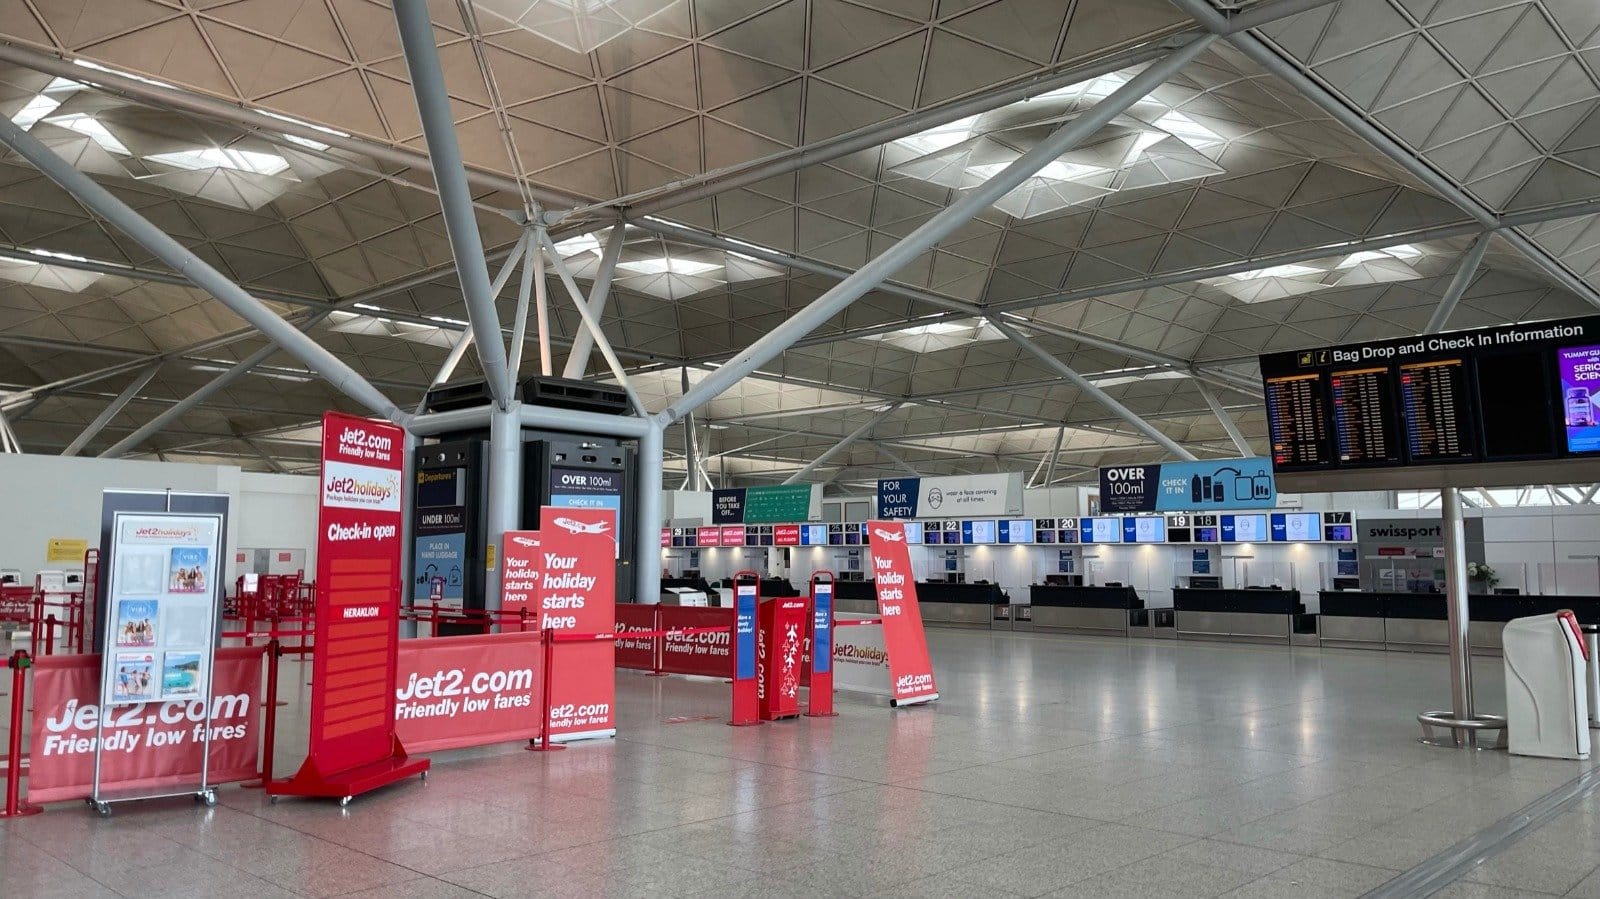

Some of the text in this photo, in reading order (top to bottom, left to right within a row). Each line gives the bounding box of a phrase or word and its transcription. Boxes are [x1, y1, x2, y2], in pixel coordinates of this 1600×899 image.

[1333, 324, 1584, 363] Bag Drop and Check In Information
[1563, 350, 1589, 359] YUMMY
[340, 427, 391, 450] Jet2.com
[339, 443, 390, 461] Friendly low fares
[561, 474, 612, 487] OVER 100ml
[1107, 468, 1145, 481] OVER
[883, 481, 900, 490] FOR
[1109, 481, 1144, 495] 100ml
[1162, 478, 1187, 487] CHECK
[883, 493, 907, 503] YOUR
[883, 506, 913, 517] SAFETY
[1331, 512, 1344, 523] 17
[422, 513, 460, 525] UNDER 100ml
[1039, 519, 1050, 528] 21
[1061, 519, 1074, 528] 20
[1173, 516, 1186, 526] 19
[1200, 515, 1212, 525] 18
[328, 522, 396, 541] Check-in open
[927, 521, 937, 530] 23
[946, 521, 957, 530] 22
[1370, 525, 1441, 540] swissport
[429, 542, 450, 551] PLACE IN
[421, 551, 458, 559] HAND LUGGAGE
[544, 553, 578, 569] Your
[506, 557, 529, 567] Your
[874, 556, 892, 569] Your
[505, 569, 539, 580] holiday
[877, 571, 905, 586] holiday
[505, 581, 533, 590] starts
[543, 573, 596, 591] holiday
[504, 592, 527, 601] here
[880, 587, 903, 600] starts
[542, 593, 585, 609] starts
[343, 607, 379, 618] HERAKLION
[882, 603, 901, 616] here
[542, 613, 576, 629] here
[625, 641, 634, 649] low
[636, 640, 651, 650] fares
[665, 642, 729, 656] Friendly low fares
[396, 669, 532, 700] Jet2.com
[896, 674, 931, 687] Jet2.com
[897, 687, 914, 695] Friendly
[46, 693, 249, 732] Jet2.com
[395, 694, 530, 720] Friendly low fares
[550, 704, 609, 718] et2.com
[549, 716, 608, 728] iendly low fares
[43, 723, 247, 755] Friendly low fares
